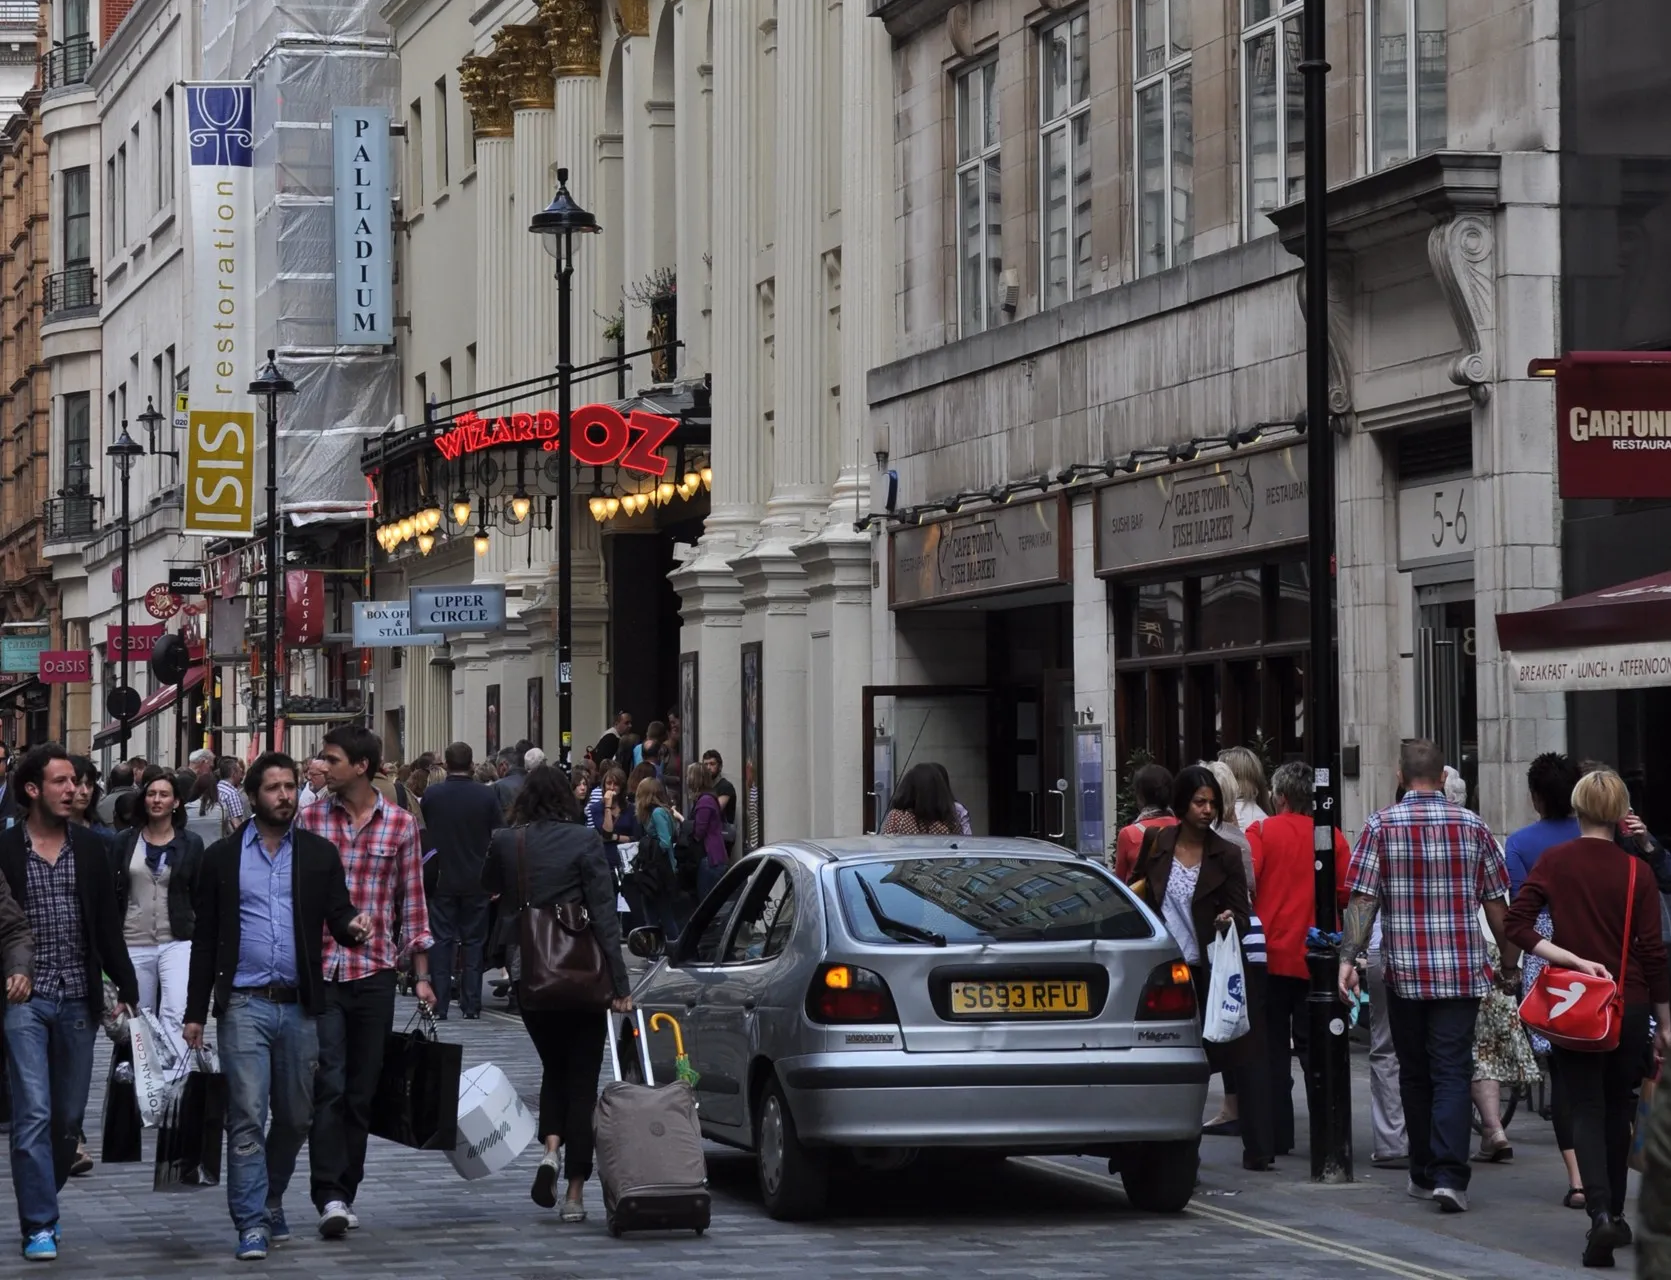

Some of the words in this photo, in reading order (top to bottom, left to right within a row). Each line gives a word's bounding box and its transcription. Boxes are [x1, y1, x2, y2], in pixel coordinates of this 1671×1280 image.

[353, 119, 377, 332] PALLADIUM
[212, 180, 235, 395] restoration
[455, 410, 478, 425] THE
[434, 410, 560, 461] WIZARD
[569, 403, 680, 477] OZ
[195, 421, 245, 523] ISIS
[1174, 489, 1200, 517] CAPE
[1202, 483, 1231, 513] TOWN
[1265, 479, 1308, 506] RESTAURAN
[1112, 516, 1130, 534] SUSHI
[1172, 521, 1193, 549] FISH
[1195, 514, 1234, 544] MARKET
[1431, 488, 1468, 548] 5-6
[953, 535, 972, 558] CAPE
[972, 531, 994, 556] TOWN
[951, 563, 966, 585] FISH
[967, 557, 997, 582] MARKET
[298, 573, 310, 643] JIGSAW
[367, 610, 388, 620] BOX
[434, 595, 484, 608] UPPER
[430, 609, 489, 623] CIRCLE
[44, 660, 86, 673] oasis
[1519, 663, 1568, 682] BREAKFAST
[1577, 661, 1608, 679] LUNCH
[962, 985, 1026, 1009] S693
[1032, 984, 1082, 1008] RFU
